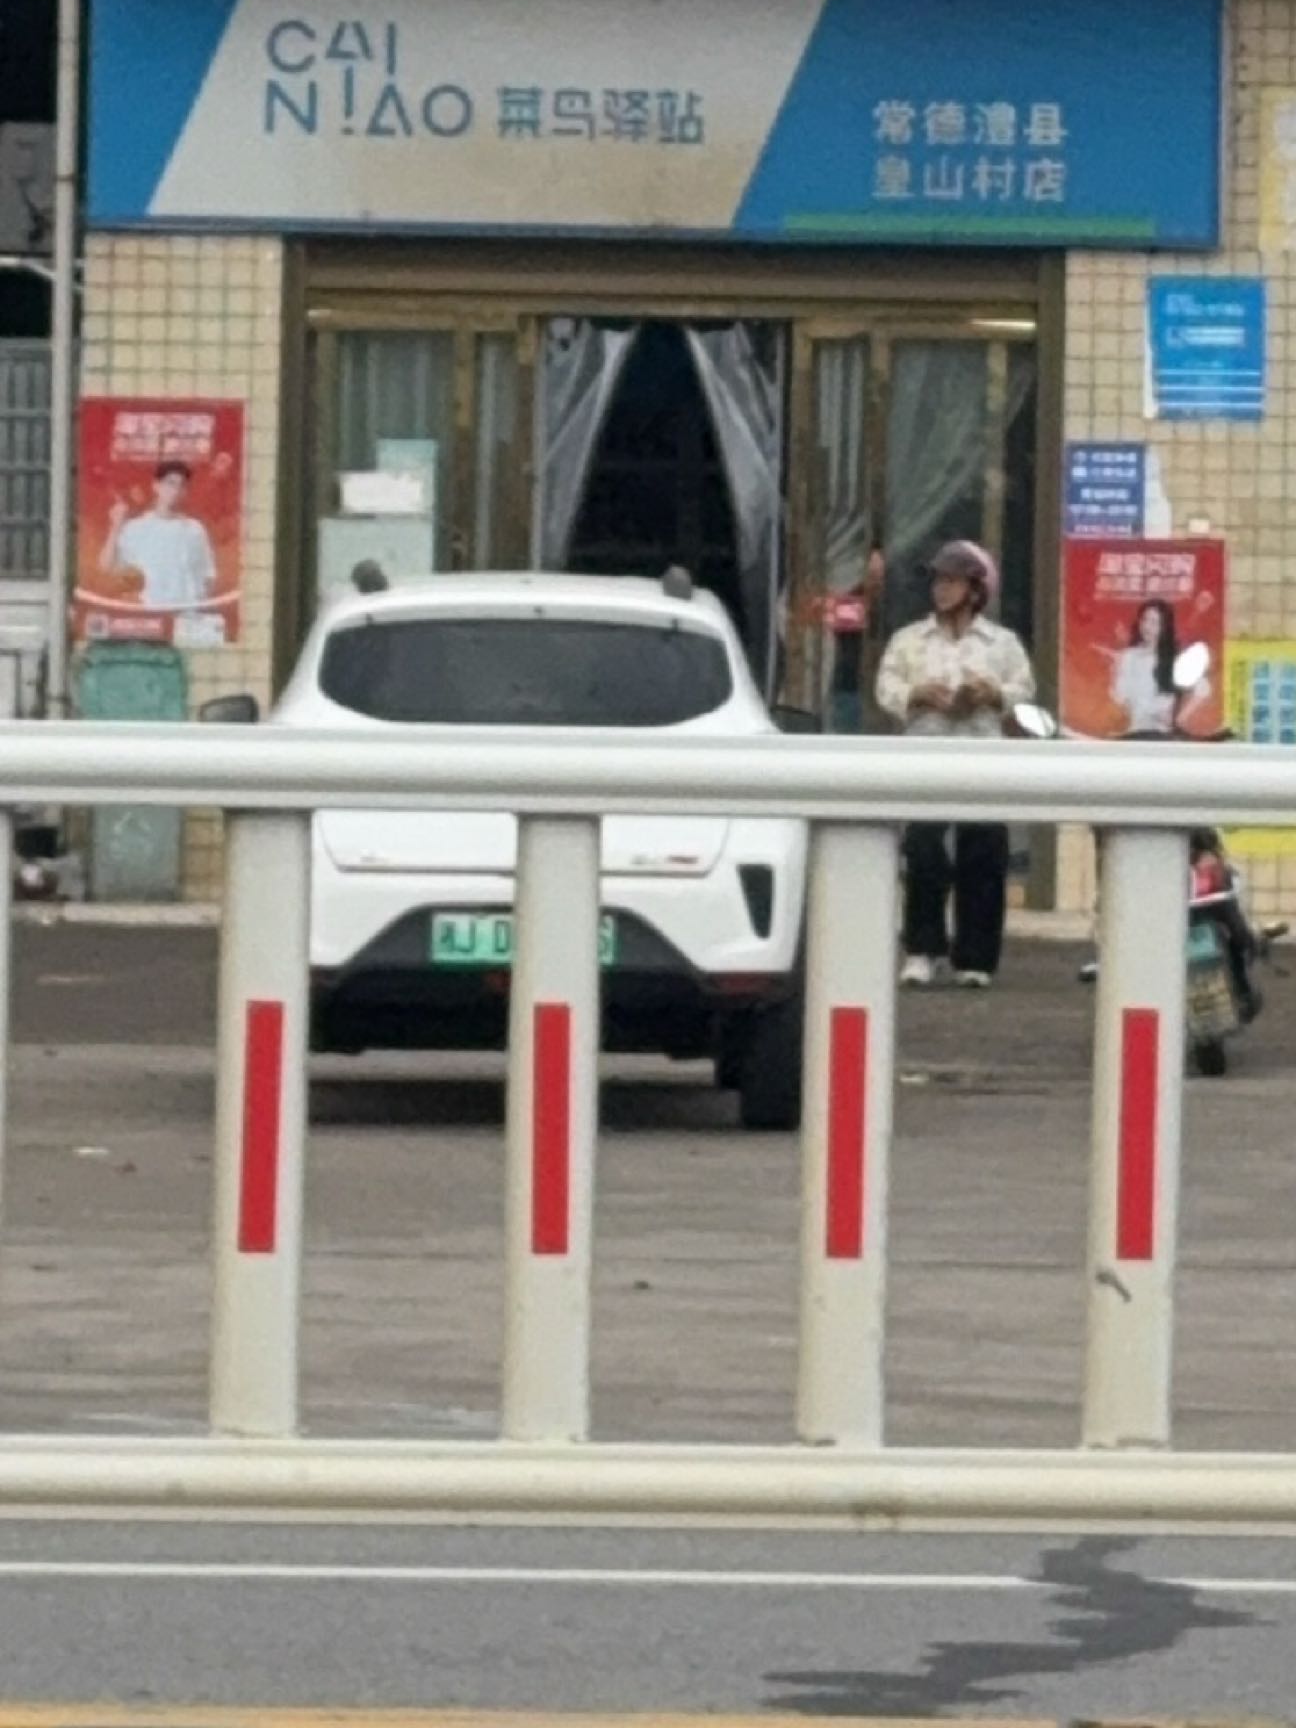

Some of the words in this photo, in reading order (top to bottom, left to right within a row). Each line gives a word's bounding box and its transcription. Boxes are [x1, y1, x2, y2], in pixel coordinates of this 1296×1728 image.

[266, 20, 398, 76] CAI
[496, 85, 705, 145] 菜鸟驿站
[872, 101, 1069, 146] 常德澧县
